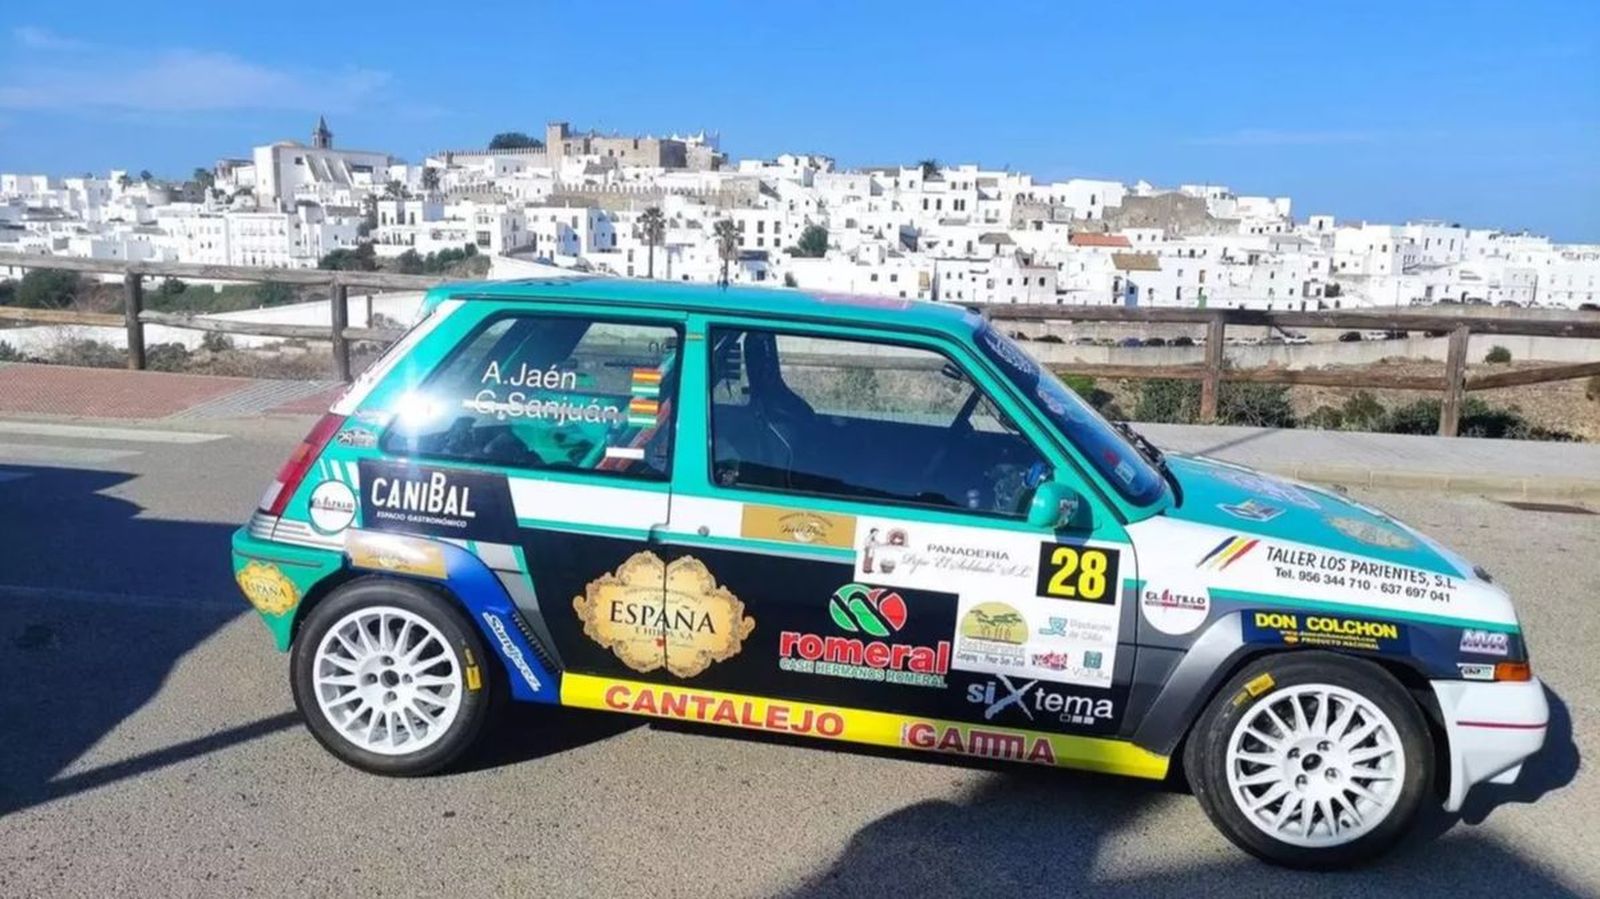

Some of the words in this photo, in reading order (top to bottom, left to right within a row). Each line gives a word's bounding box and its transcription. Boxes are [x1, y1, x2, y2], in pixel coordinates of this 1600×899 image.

[482, 360, 577, 389] A.Jaén
[475, 390, 619, 426] G.Sanjuán
[376, 511, 406, 521] ESPACIO
[1047, 547, 1108, 599] 28
[1266, 546, 1318, 568] TALLER
[1320, 555, 1347, 571] LOS
[1349, 559, 1431, 587] PARIENTES,
[1434, 574, 1457, 590] S.L.
[1274, 566, 1295, 580] Tel.
[1299, 570, 1321, 583] 956
[1323, 574, 1346, 586] 344
[1349, 577, 1372, 591] 710
[1381, 583, 1402, 595] 637
[1405, 586, 1427, 599] 697
[1430, 590, 1451, 603] 041
[610, 600, 717, 635] ESPAÑA
[1254, 613, 1297, 629] DON
[1305, 616, 1398, 639] COLCHON
[780, 631, 951, 675] romeral
[779, 658, 814, 674] CASH
[815, 661, 885, 682] HERMANOS
[886, 669, 948, 688] ROMERAL
[605, 685, 844, 737] CANTALEJO
